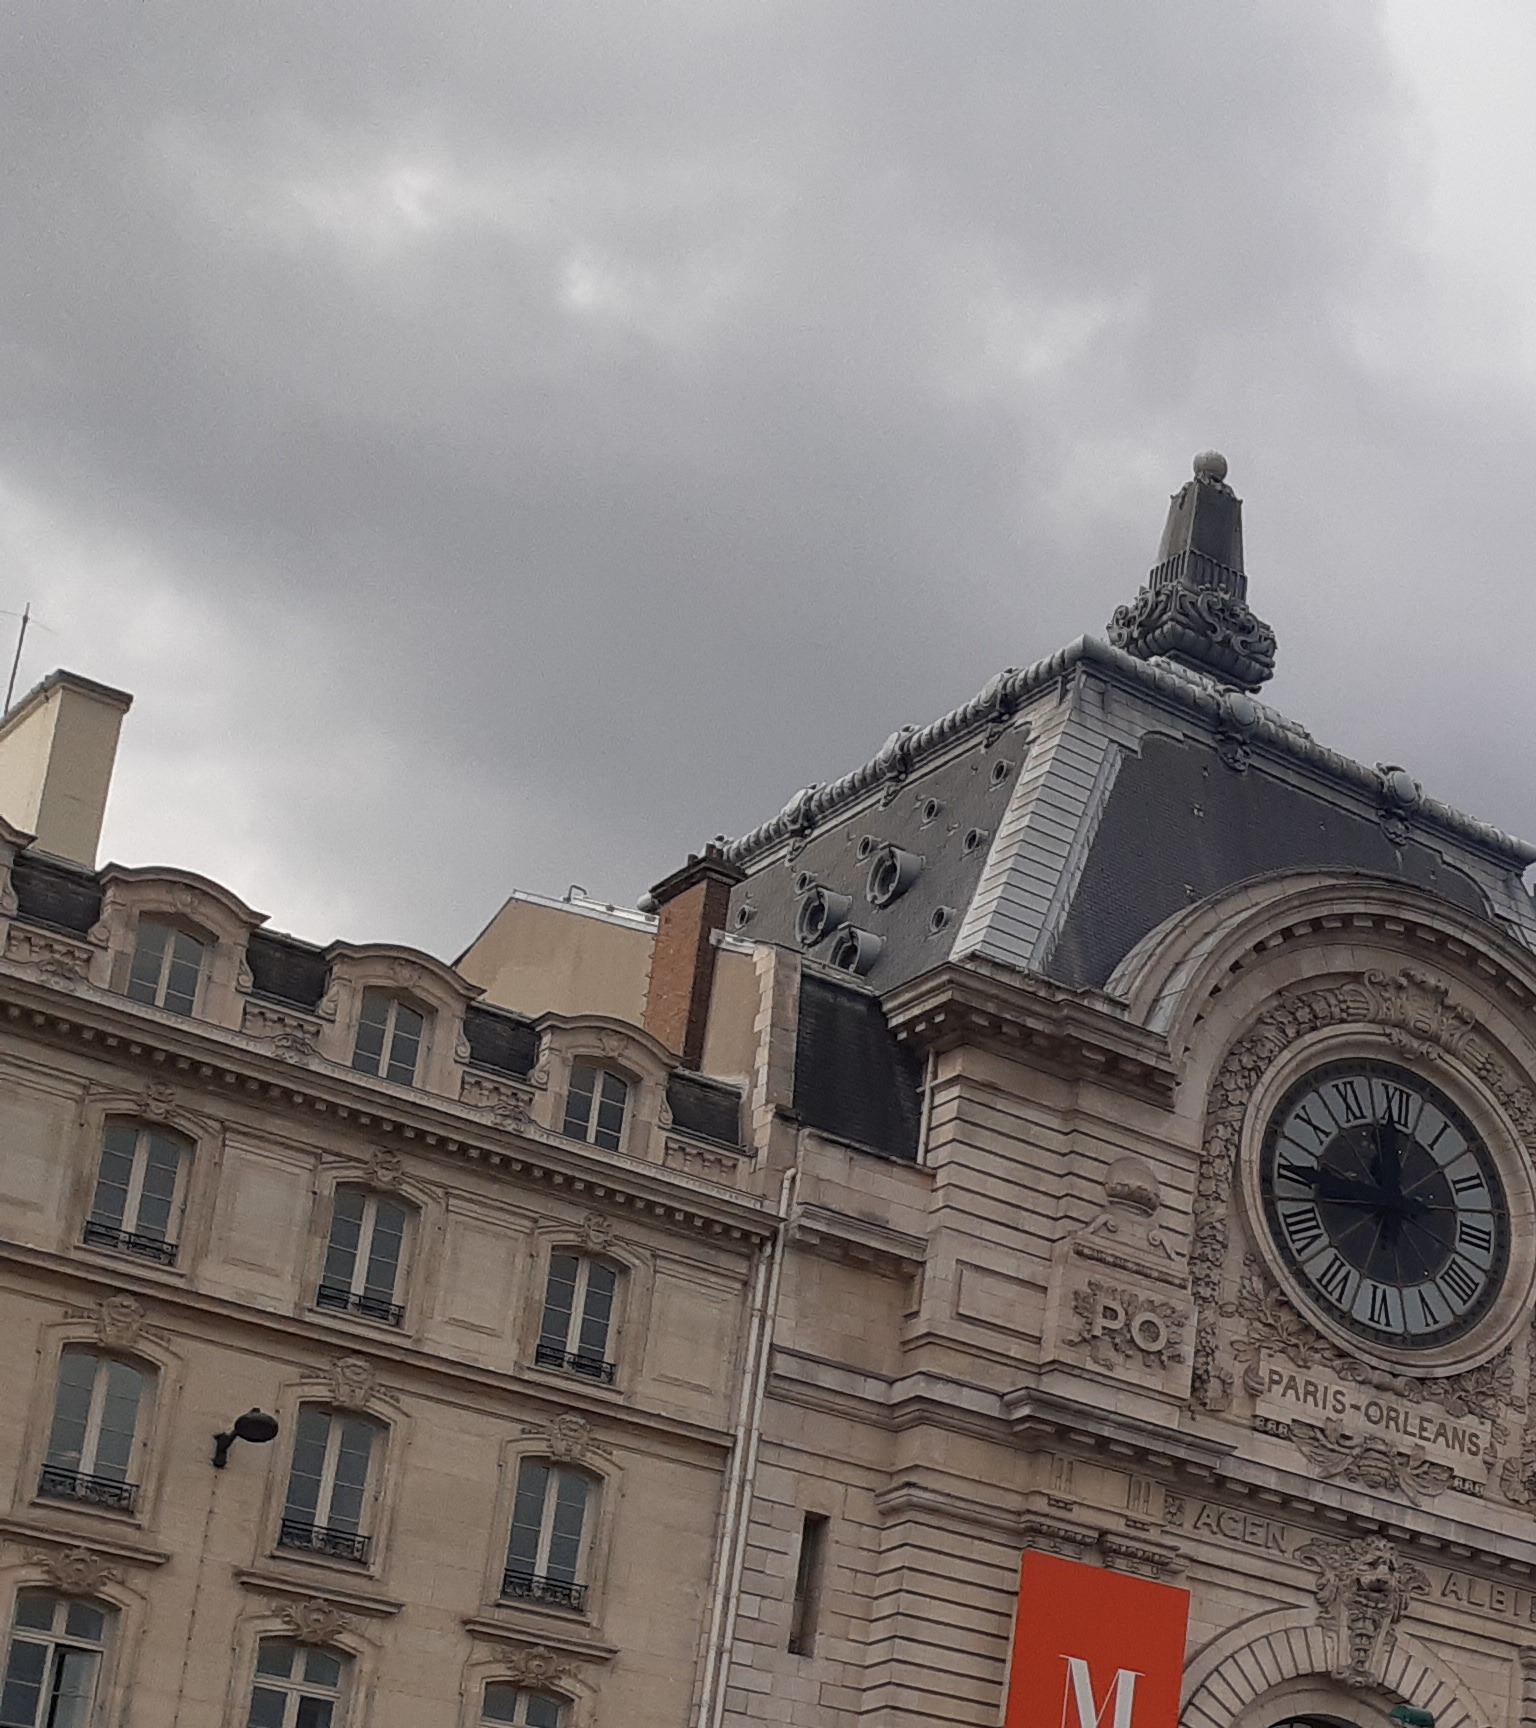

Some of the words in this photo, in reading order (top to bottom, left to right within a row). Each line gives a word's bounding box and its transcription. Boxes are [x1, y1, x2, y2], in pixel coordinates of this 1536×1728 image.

[1090, 1300, 1168, 1353] PO
[1266, 1368, 1482, 1457] PARIS-ORLEANS
[1441, 1571, 1520, 1617] ALBI
